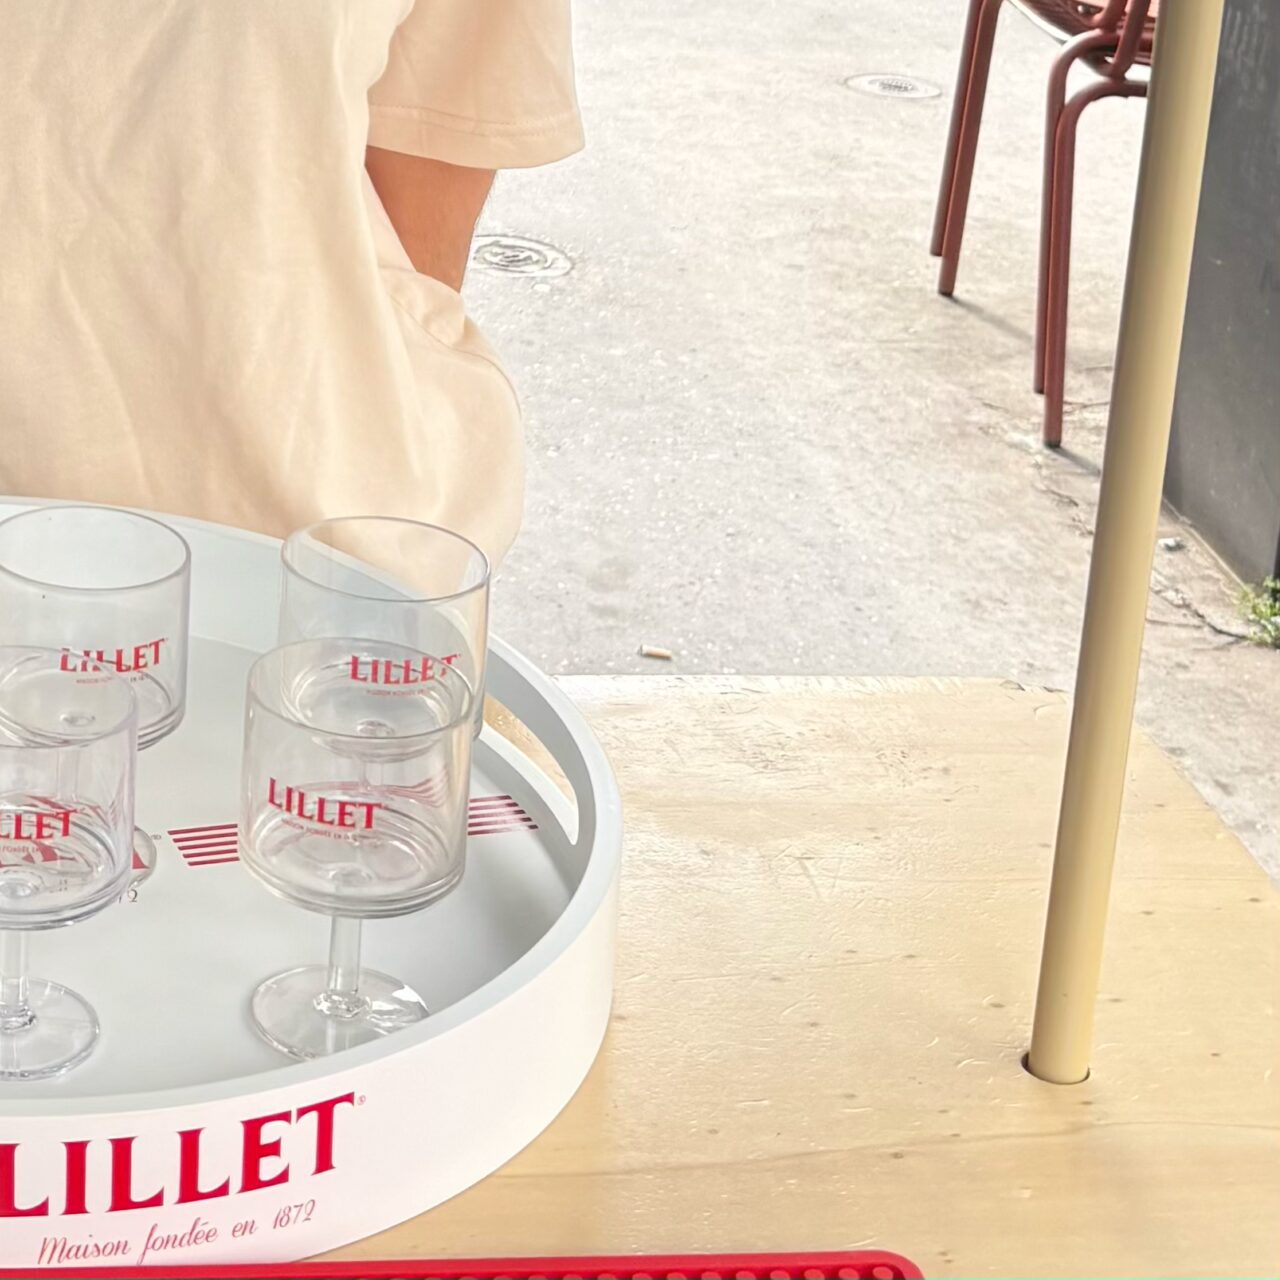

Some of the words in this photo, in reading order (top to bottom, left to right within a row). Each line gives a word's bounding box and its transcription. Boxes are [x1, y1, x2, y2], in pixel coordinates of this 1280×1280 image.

[60, 638, 166, 673] LILLET
[351, 654, 458, 685] LILLET
[267, 777, 384, 830] LILLET
[37, 1233, 132, 1265] Maison
[137, 1216, 219, 1266] fondée
[231, 1218, 259, 1238] en
[271, 1199, 317, 1231] 1872
